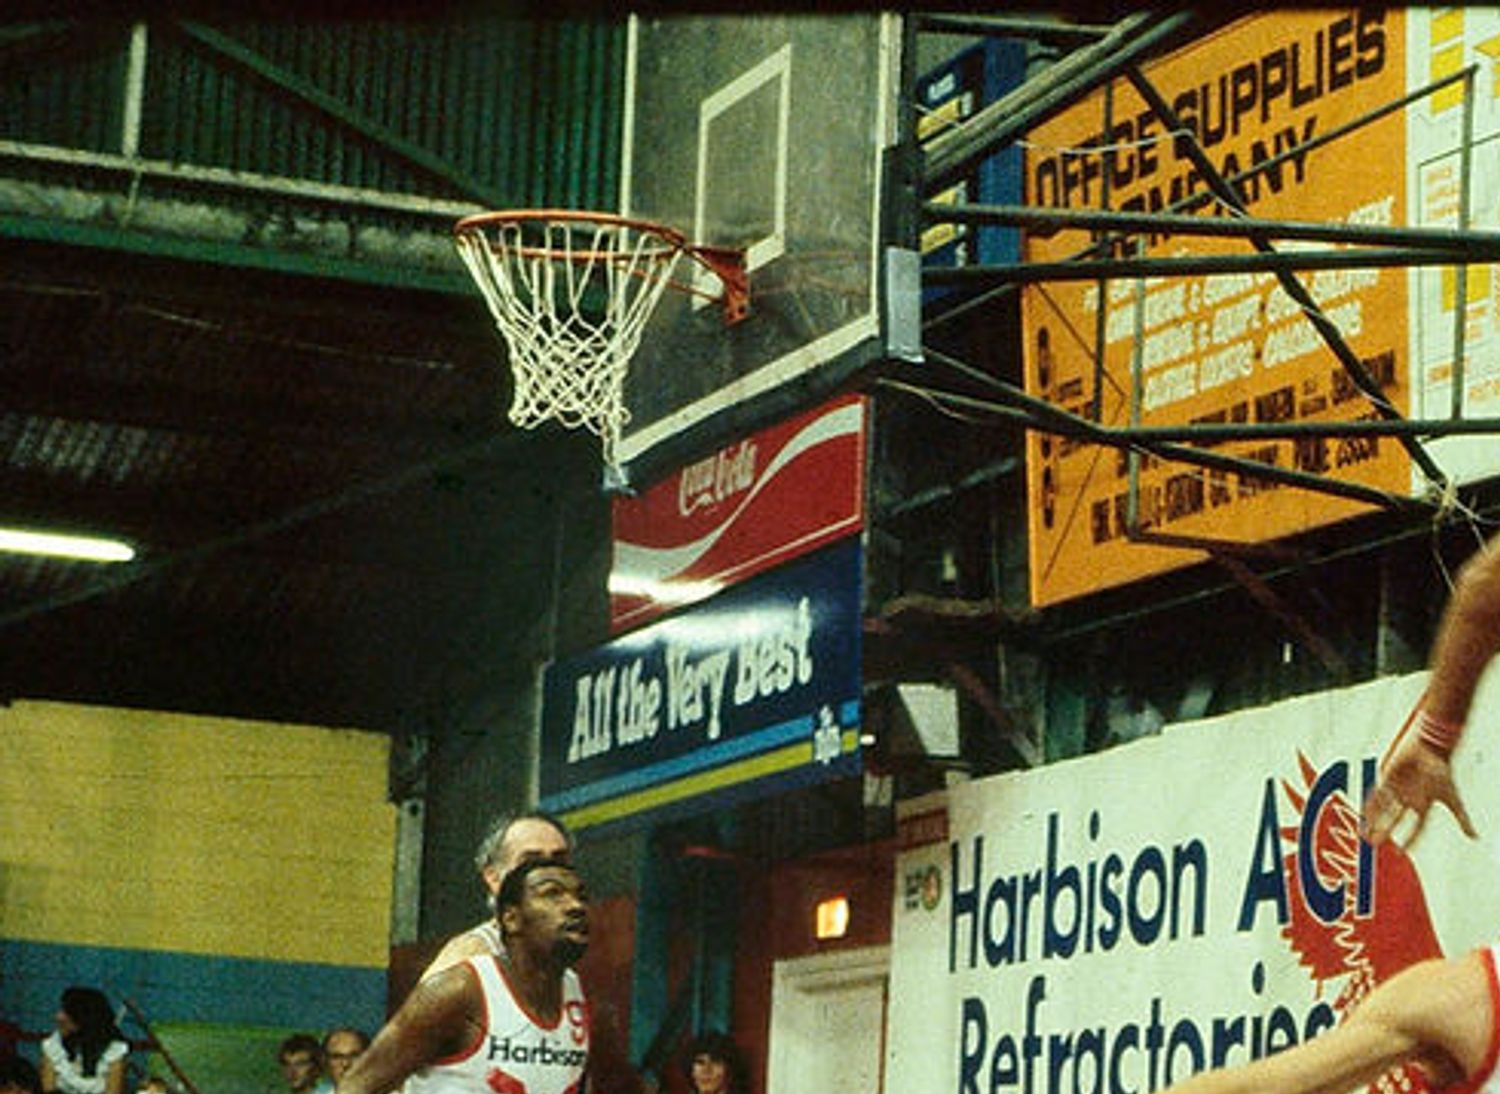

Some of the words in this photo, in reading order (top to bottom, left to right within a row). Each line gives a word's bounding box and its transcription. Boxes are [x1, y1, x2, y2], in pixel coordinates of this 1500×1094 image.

[1036, 110, 1158, 232] OFFCE
[1173, 7, 1387, 161] SUPPLIES
[1092, 116, 1317, 262] OMPANY
[567, 665, 616, 764] All
[617, 657, 662, 746] the
[665, 641, 731, 740] Very
[734, 596, 813, 706] Best
[949, 811, 1208, 973] Harbison
[1236, 757, 1377, 932] ACI
